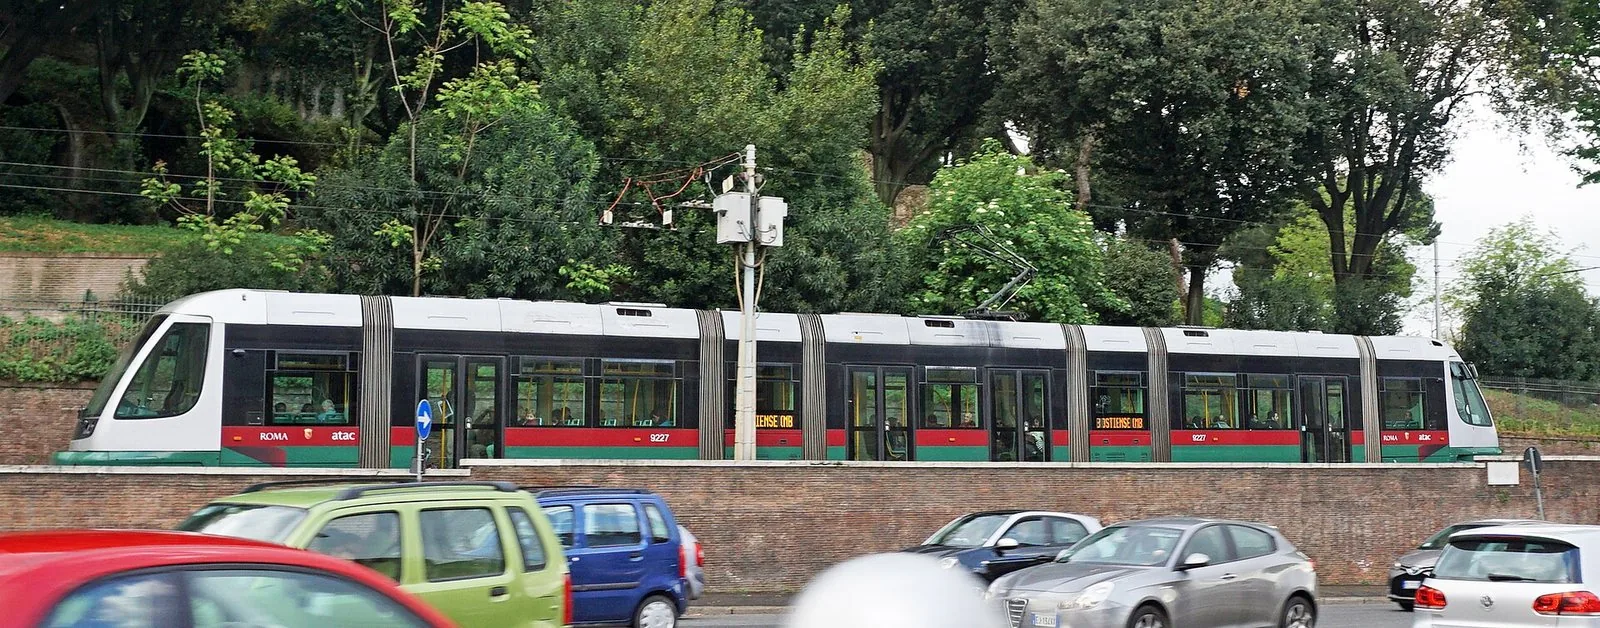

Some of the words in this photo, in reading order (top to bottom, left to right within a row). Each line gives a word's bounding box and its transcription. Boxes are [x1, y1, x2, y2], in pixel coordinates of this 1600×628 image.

[260, 432, 288, 441] ROMA
[331, 430, 356, 441] atac
[650, 433, 670, 443] 9227
[1418, 433, 1432, 441] atac
